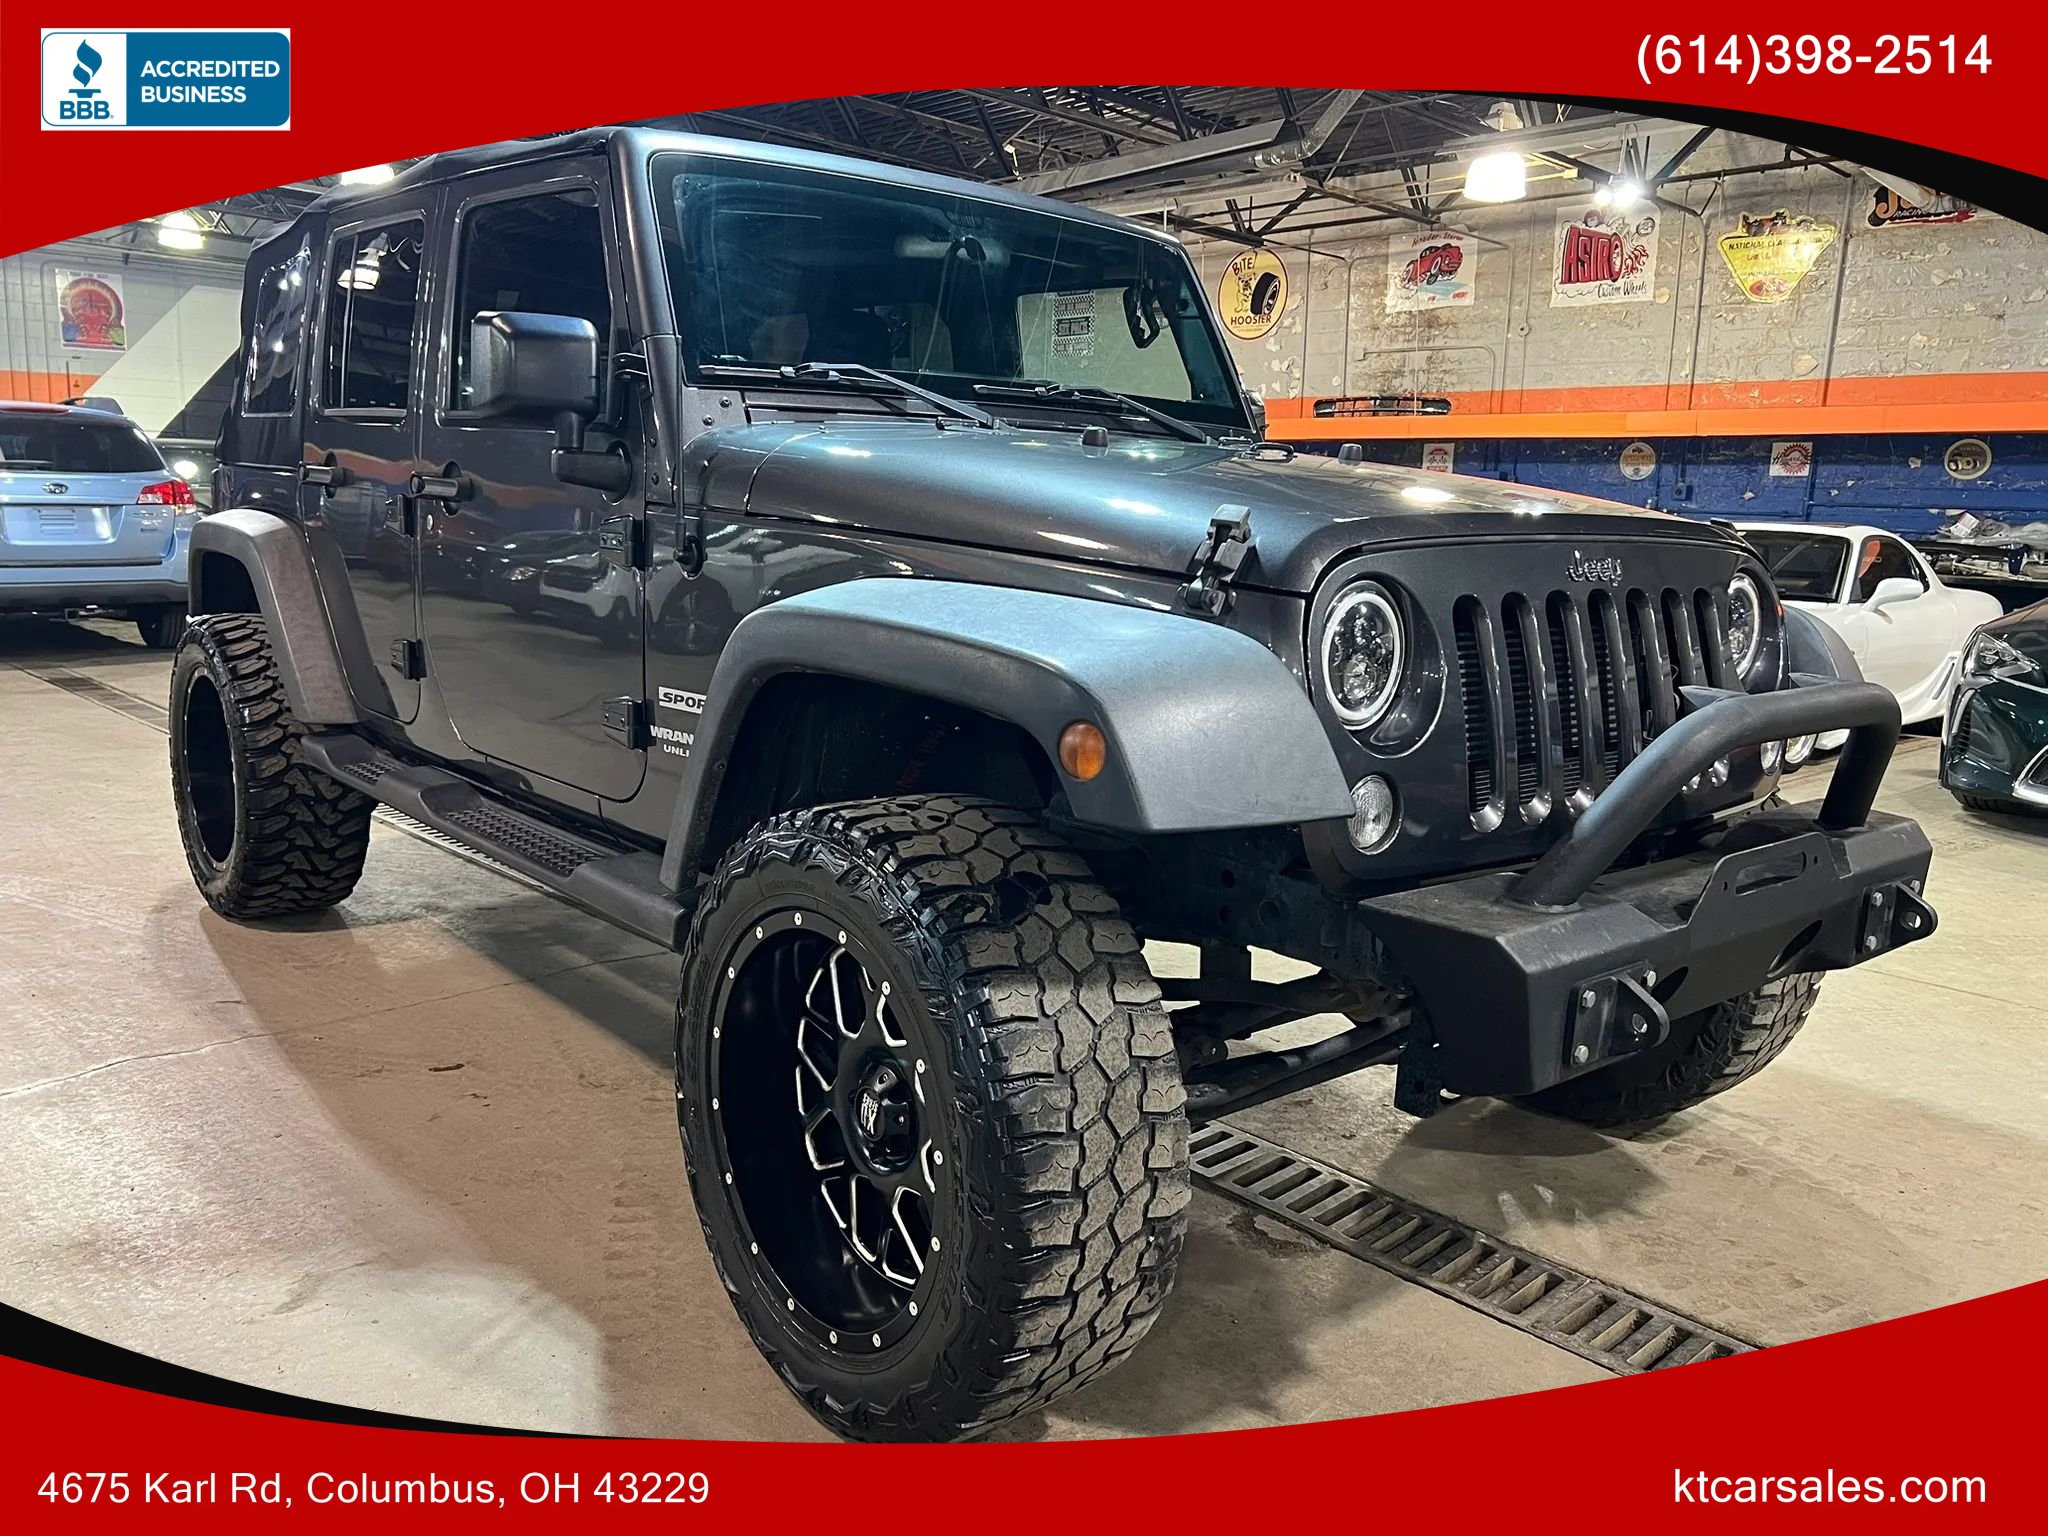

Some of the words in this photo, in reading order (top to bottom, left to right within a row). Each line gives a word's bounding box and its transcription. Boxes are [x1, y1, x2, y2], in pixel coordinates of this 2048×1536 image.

[1560, 224, 1624, 284] ASTRO
[1230, 315, 1272, 326] HOOSIER
[1568, 550, 1623, 587] Jeep
[662, 693, 705, 709] SPOR
[650, 725, 694, 745] WRAN
[663, 744, 690, 757] UNLI
